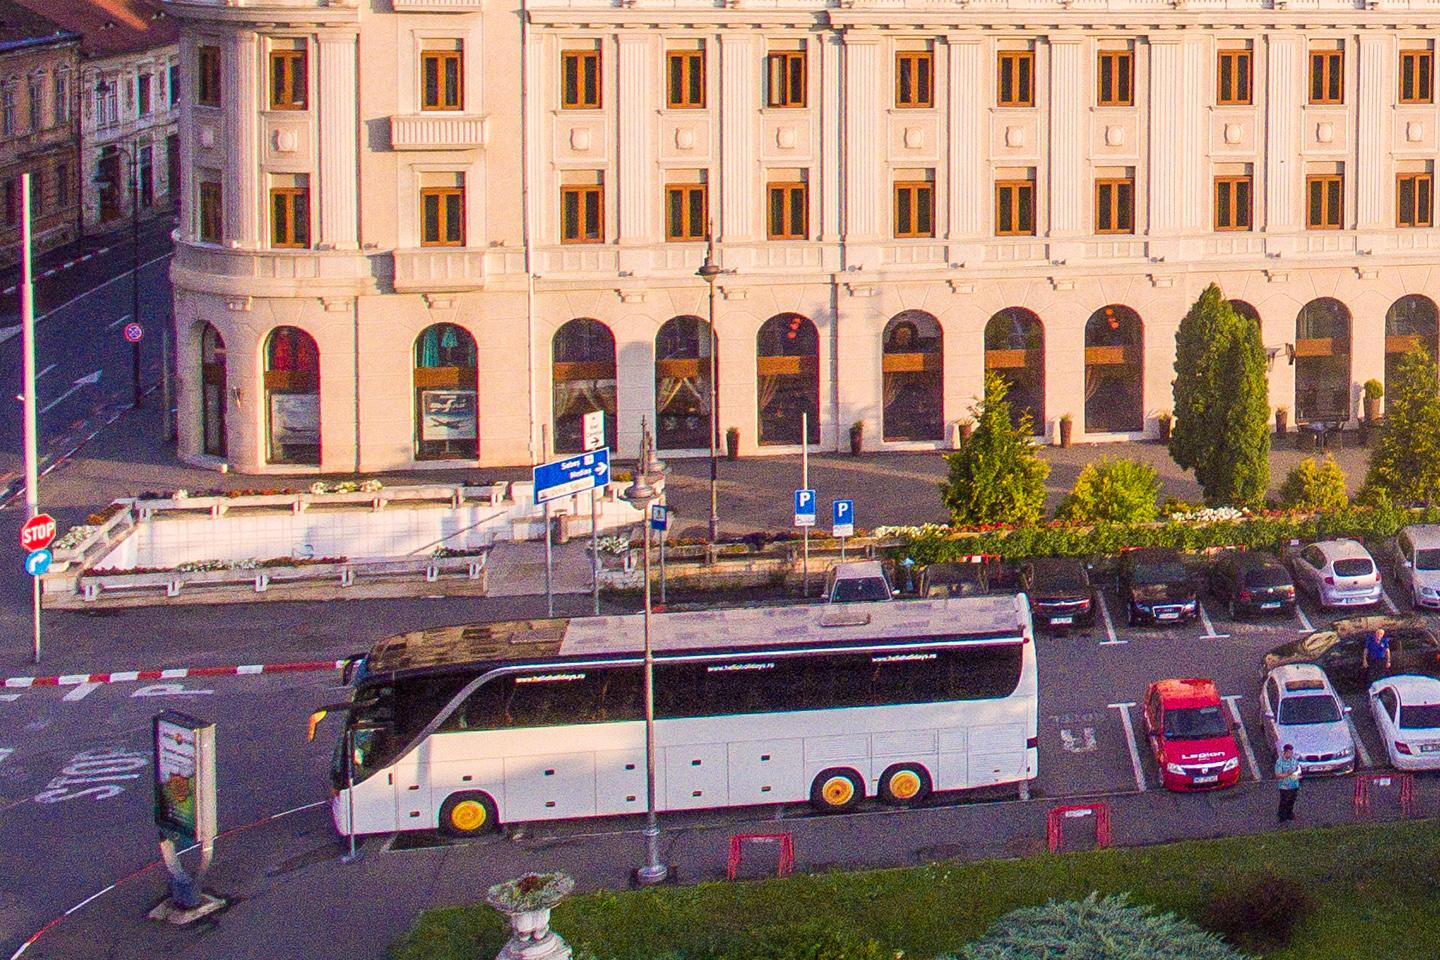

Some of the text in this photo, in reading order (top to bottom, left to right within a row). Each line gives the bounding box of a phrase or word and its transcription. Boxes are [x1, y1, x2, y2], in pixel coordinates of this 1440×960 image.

[799, 492, 811, 507] P
[838, 502, 849, 517] P
[24, 521, 55, 544] STOP
